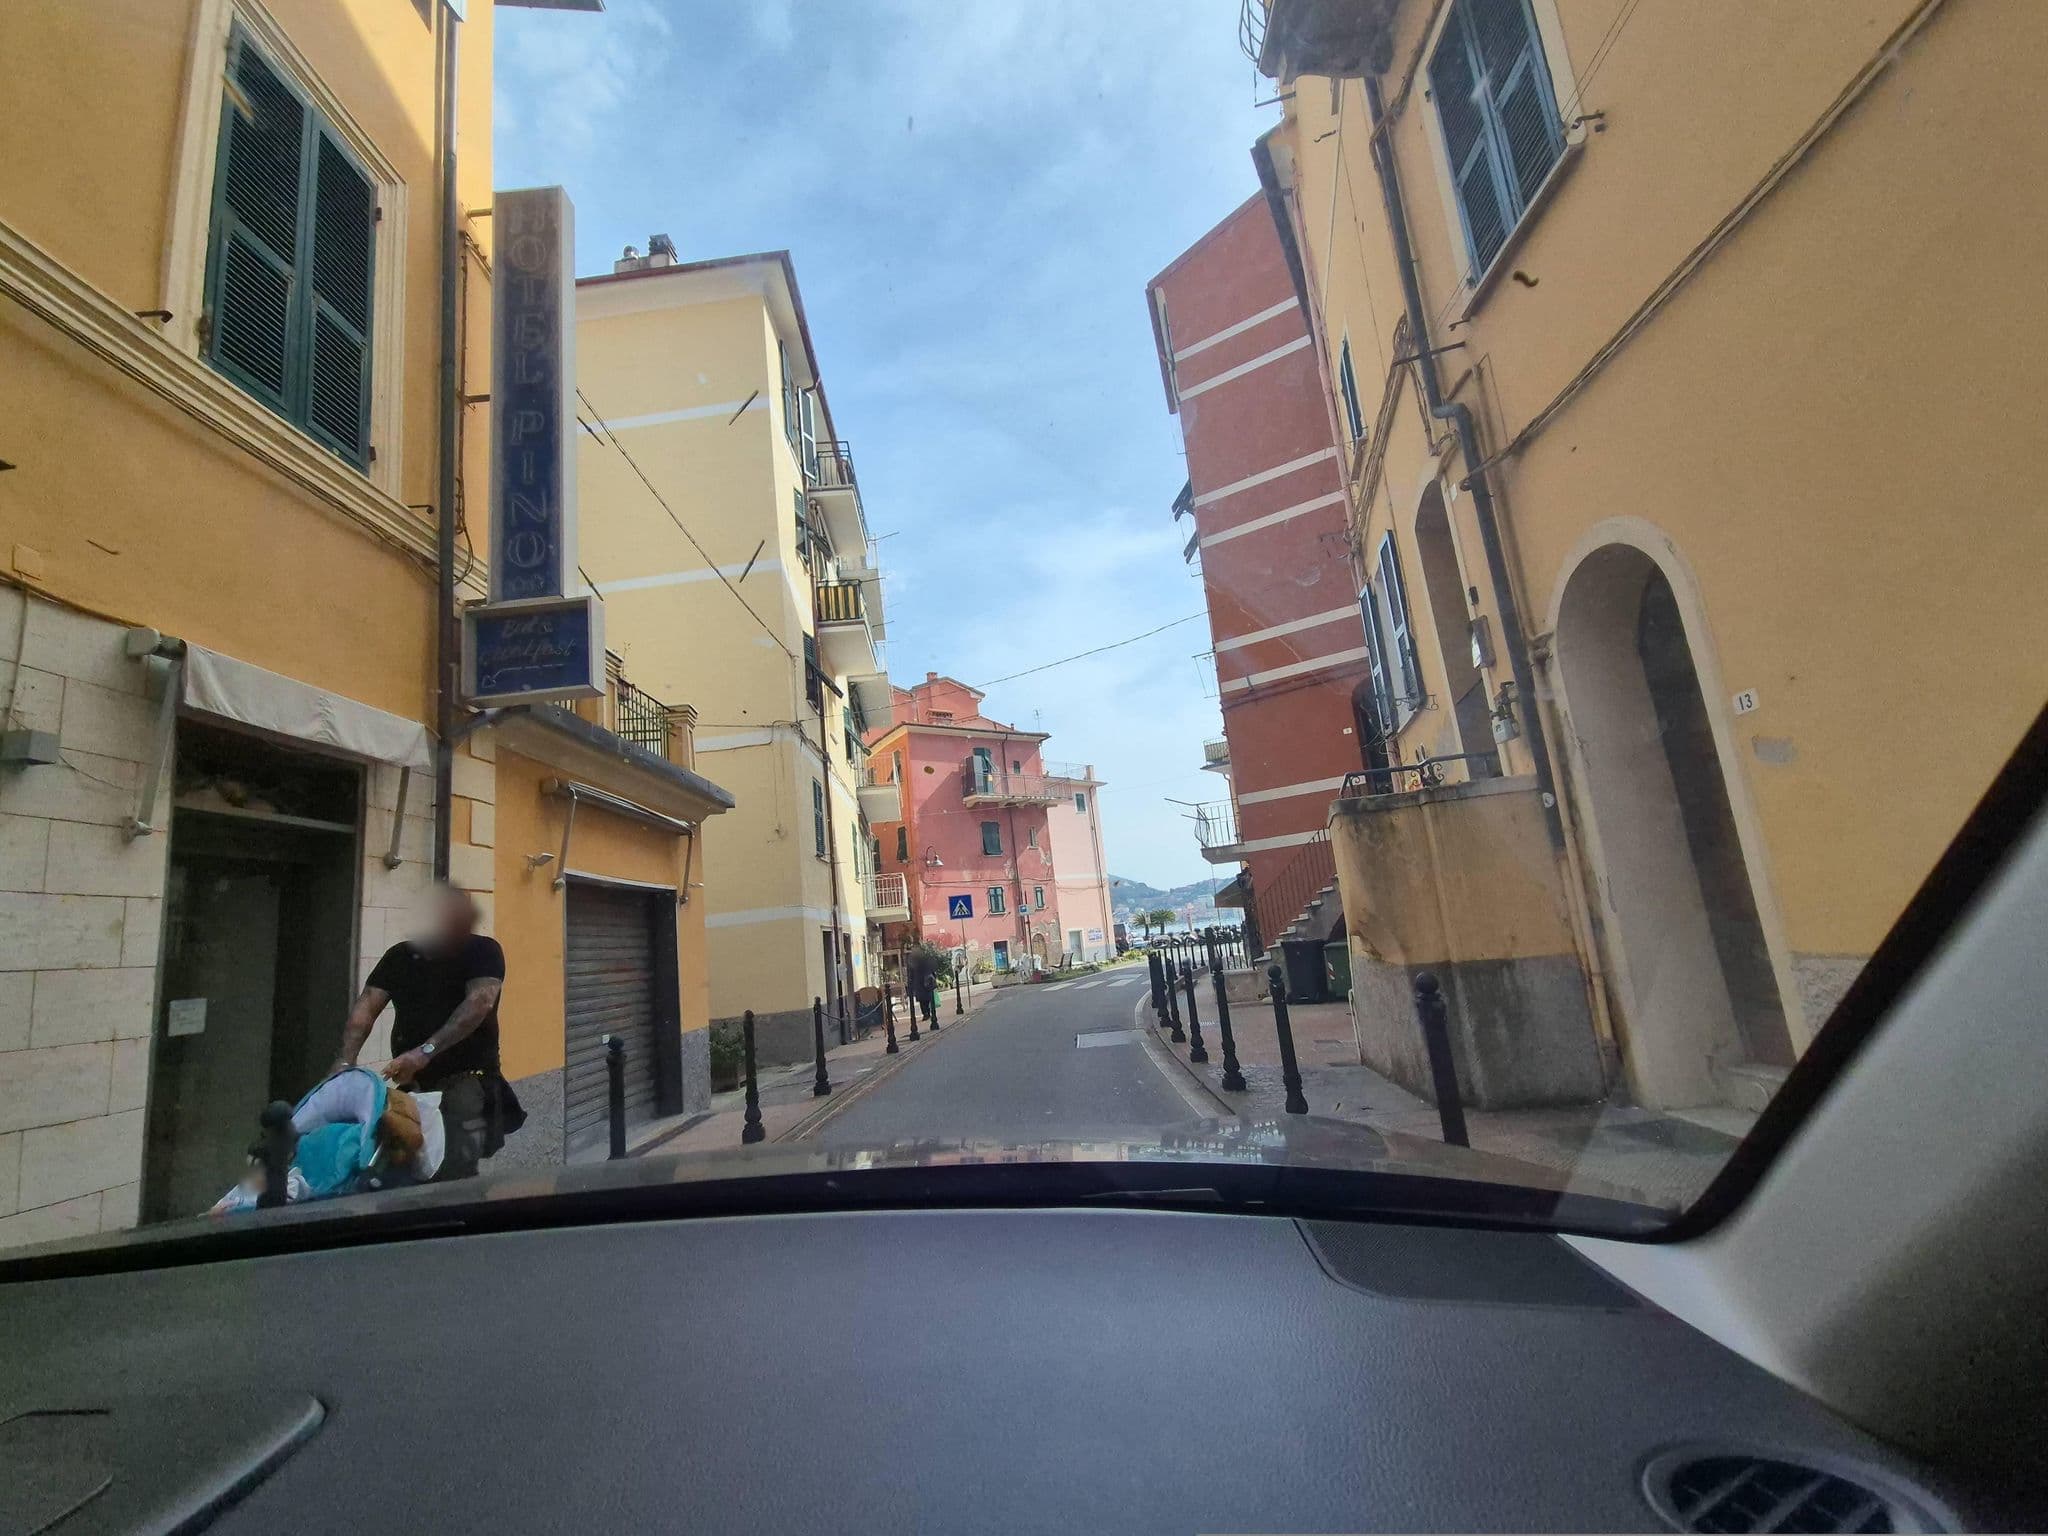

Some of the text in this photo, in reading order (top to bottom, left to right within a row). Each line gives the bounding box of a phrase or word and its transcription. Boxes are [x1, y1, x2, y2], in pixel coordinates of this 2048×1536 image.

[507, 205, 547, 568] HOTEL PINO
[1738, 693, 1753, 711] 13
